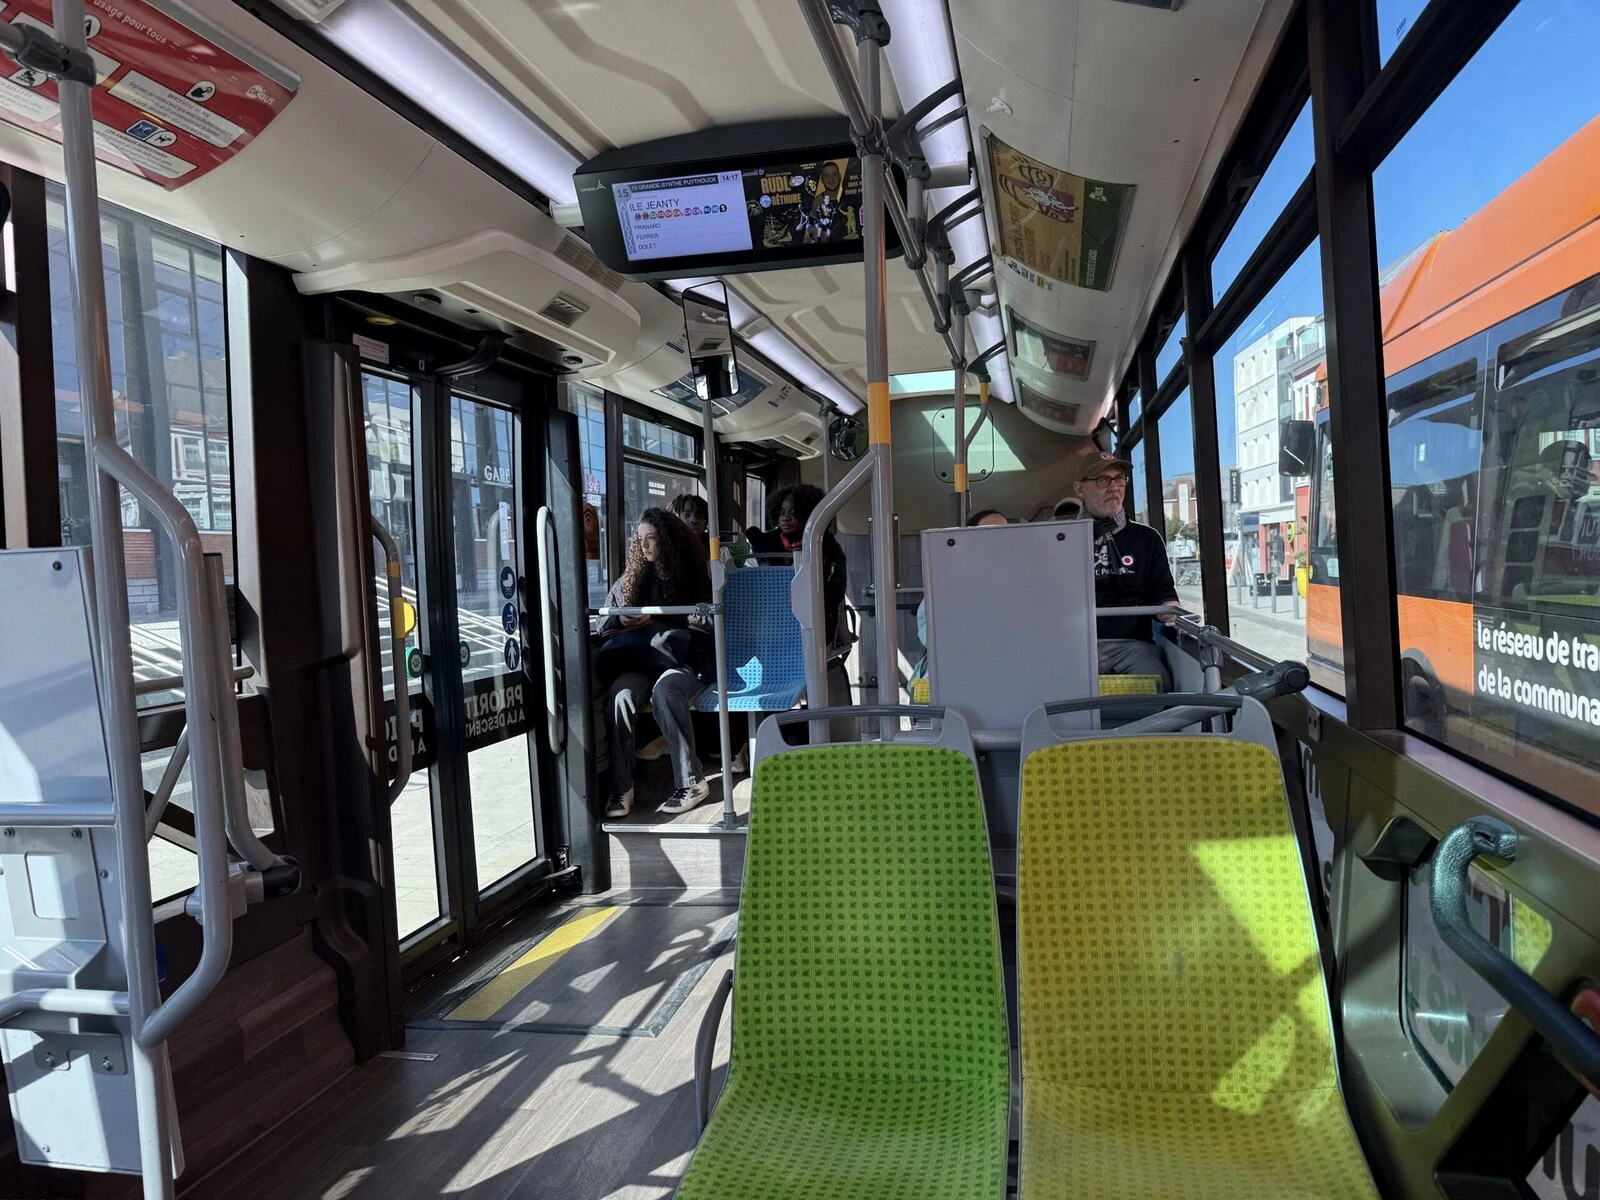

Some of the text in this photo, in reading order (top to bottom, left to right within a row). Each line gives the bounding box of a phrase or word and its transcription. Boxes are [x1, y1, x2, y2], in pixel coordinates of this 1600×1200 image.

[92, 0, 168, 44] usage pour tous
[722, 174, 738, 182] 14:17
[617, 189, 629, 198] 15
[772, 193, 801, 206] BÉTHUNE
[629, 199, 679, 211] ILE JEANTY
[484, 465, 511, 483] GARE
[1478, 619, 1600, 672] le réseau de tra
[1478, 664, 1496, 695] de
[1497, 667, 1512, 700] la
